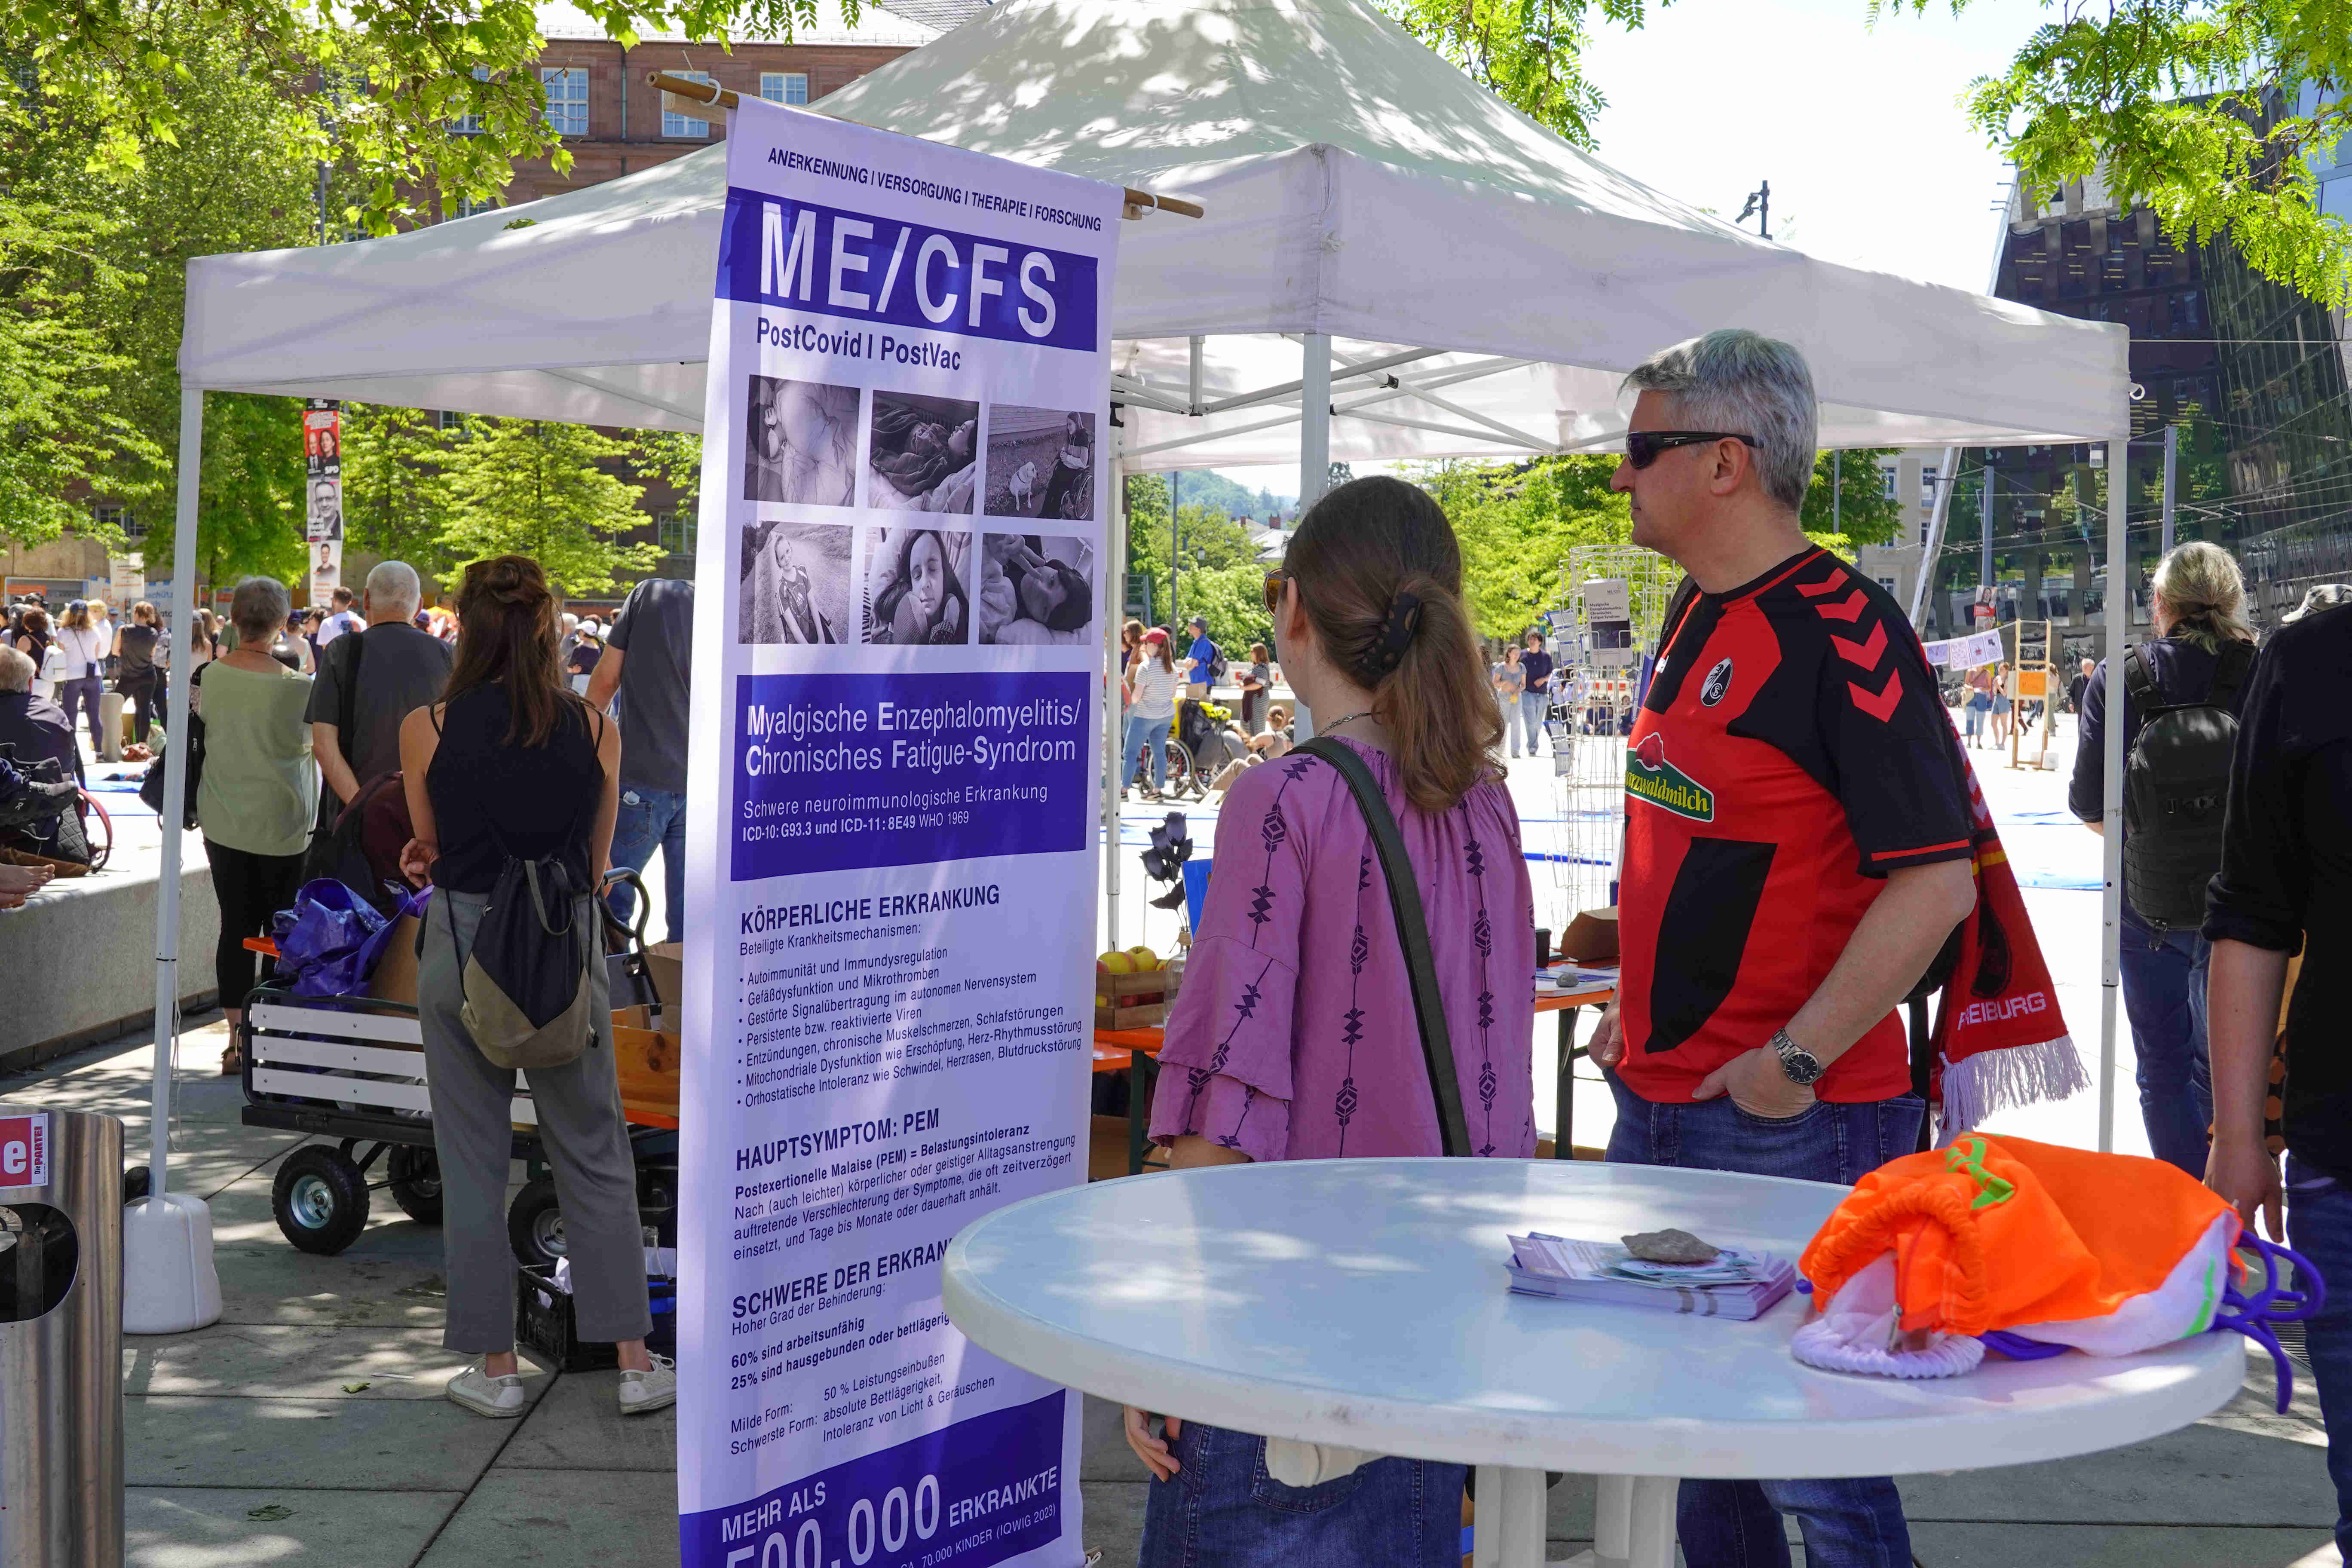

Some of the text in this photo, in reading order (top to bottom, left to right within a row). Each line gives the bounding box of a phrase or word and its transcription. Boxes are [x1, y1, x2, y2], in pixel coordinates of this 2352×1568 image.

[768, 148, 868, 184] ANERKENNUNG
[878, 172, 961, 203] VERSORGUNG
[972, 192, 1027, 217] THERAPIE
[1035, 205, 1101, 231] FORSCHUNG
[760, 201, 1056, 337] ME/CFS
[757, 316, 861, 358] PostCovid
[881, 336, 961, 371] PostVac
[747, 699, 1081, 743] Myalgische Enzephalomyelitis/
[746, 735, 1075, 776] Chronisches Fatigue-Syndrom
[744, 784, 1047, 818] Schwere neuroimmunologische Erkrankung
[815, 819, 837, 834] und
[919, 812, 943, 827] WHO
[948, 811, 969, 824] 1969
[740, 924, 920, 956] Beteiligte Krankheitsmechanismen:
[741, 885, 999, 934] KÖRPERLICHE ERKRANKUNG
[747, 947, 947, 986] Autoimmunität und Immundysregulation
[748, 968, 939, 1005] Gefäßdysfunktion und Mikrothromben
[747, 1008, 921, 1046] Persistente bzw. reaktivierte Viren
[748, 973, 1036, 1026] Gestörte Signalübertragung im autonomen Nervensystem
[747, 1007, 1063, 1066] Entzündungen, chronische Muskelschmerzen, Schlafstörungen
[747, 1021, 1081, 1087] Mitochondriale Dysfunktion wie Erschöpfung, Herz-Rhythmusstörung
[746, 1038, 1081, 1107] Orthostatische Intoleranz wie Schwindel, Herzrasen, Blutdruckstörung
[34, 1126, 43, 1166] PARTEI
[736, 1168, 827, 1199] Postexertionelle
[832, 1159, 872, 1177] Malaise
[877, 1148, 906, 1170] (PEM)
[922, 1126, 1029, 1156] Belastungsintoleranz
[737, 1108, 939, 1171] HAUPTSYMPTOM: PEM
[734, 1152, 1071, 1240] auftretende Verschlechterung der Symptome, die oft zeitverzögert
[735, 1135, 1075, 1219] Nach (auch leichter) körperlicher oder geistiger Alltagsanstrengung
[734, 1182, 1000, 1260] einsetzt, und Tage bis Monate oder dauerhaft anhält.
[733, 1238, 952, 1318] SCHWERE DER ERKRAN
[732, 1283, 885, 1335] Hoher Grad der Behinderung:
[731, 1312, 949, 1390] 25% sind hausgebunden oder bettlägerig
[732, 1318, 864, 1368] 60% sind arbeitsunfähig
[731, 1373, 942, 1455] Schwerste Form: absolute Bettlägerigkeit,
[732, 1415, 762, 1433] Milde
[766, 1404, 792, 1422] Form:
[824, 1387, 836, 1401] 50
[853, 1354, 944, 1391] Leistungseinbußen
[824, 1417, 873, 1442] Intoleranz
[879, 1410, 896, 1423] von
[901, 1399, 923, 1417] Licht
[938, 1377, 994, 1403] Geräuschen
[723, 1482, 825, 1543] MEHR ALS
[950, 1466, 1057, 1527] ERKRANKTE
[922, 1503, 1055, 1568] 70.000 KINDER (IQWIG 2023)
